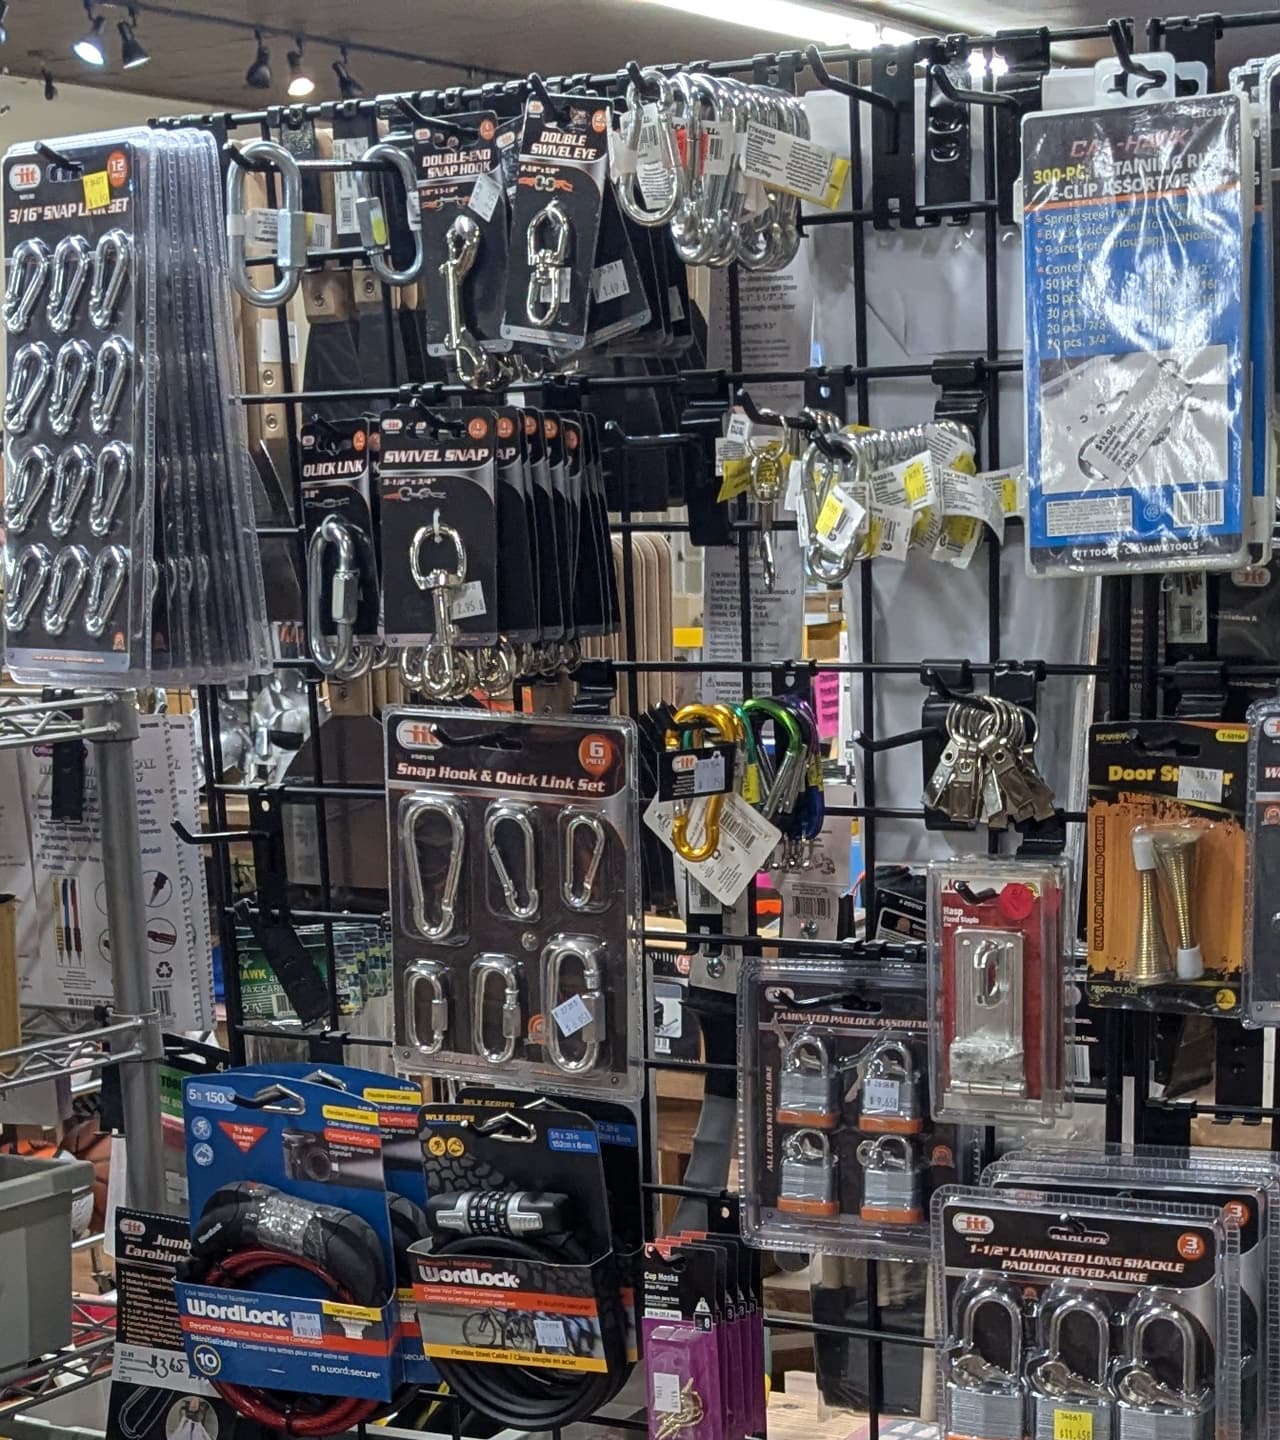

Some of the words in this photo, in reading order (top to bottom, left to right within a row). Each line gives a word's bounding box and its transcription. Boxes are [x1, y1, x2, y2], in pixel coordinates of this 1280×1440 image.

[541, 132, 586, 146] DOUBLE
[423, 150, 491, 167] DOUBLE-END
[530, 144, 572, 157] SWIVEL
[574, 147, 597, 159] EYE
[111, 160, 124, 171] 12
[428, 164, 458, 177] SNAP
[459, 161, 490, 174] HOOK
[43, 203, 76, 220] SNAP
[383, 450, 441, 464] SWIVEL
[445, 449, 489, 463] SNAP
[303, 461, 334, 477] QUICK
[336, 458, 364, 473] LINK
[589, 742, 605, 758] 6
[397, 762, 436, 779] Snap
[438, 766, 477, 781] Hook
[480, 771, 493, 782] &
[495, 771, 537, 787] Quick
[541, 776, 579, 790] Link
[577, 779, 606, 792] Set
[1108, 765, 1154, 783] Door
[1095, 816, 1104, 853] GARDEN
[773, 1011, 827, 1024] LAMINATED
[830, 1014, 874, 1027] PADLOCK
[1185, 1236, 1198, 1248] 3
[1010, 1248, 1085, 1263] LAMINATED
[1087, 1254, 1121, 1267] LONG
[1123, 1259, 1184, 1272] SHACKLE
[644, 1271, 657, 1280] Cup
[658, 1273, 678, 1282] Hooks
[1002, 1260, 1061, 1274] PADLOCK
[1063, 1267, 1148, 1282] KEYED-ALIKE
[197, 1352, 217, 1367] 10
